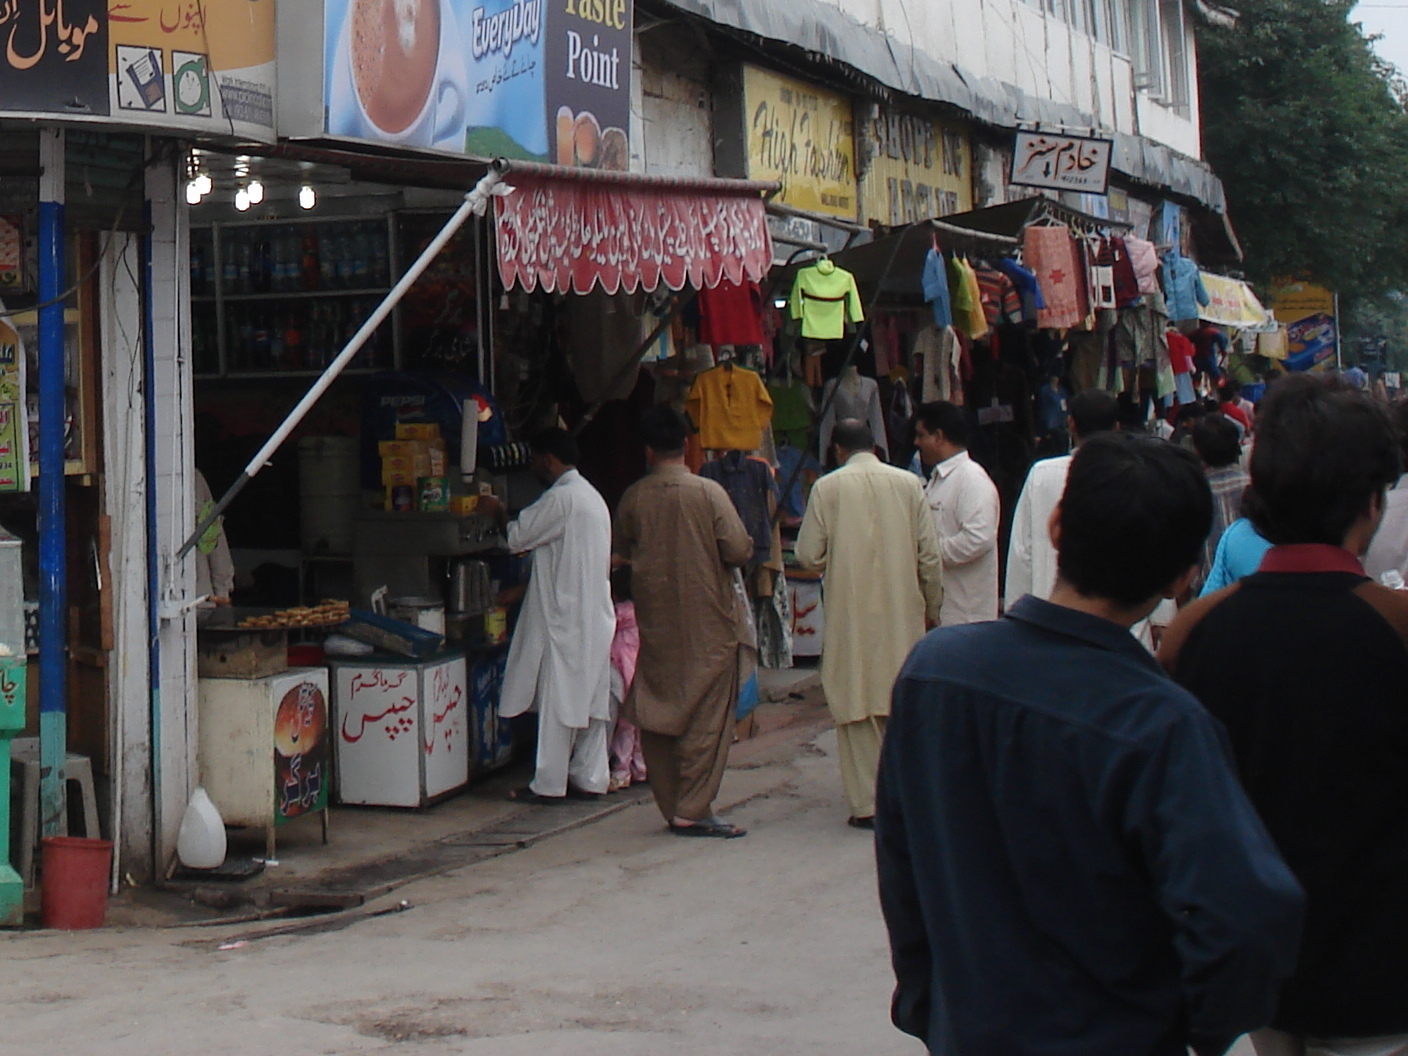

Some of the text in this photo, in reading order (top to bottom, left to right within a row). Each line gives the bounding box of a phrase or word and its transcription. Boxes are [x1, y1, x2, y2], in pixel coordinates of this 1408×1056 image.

[108, 4, 149, 22] سے
[566, 31, 620, 90] Point
[381, 396, 424, 406] PEPSI
